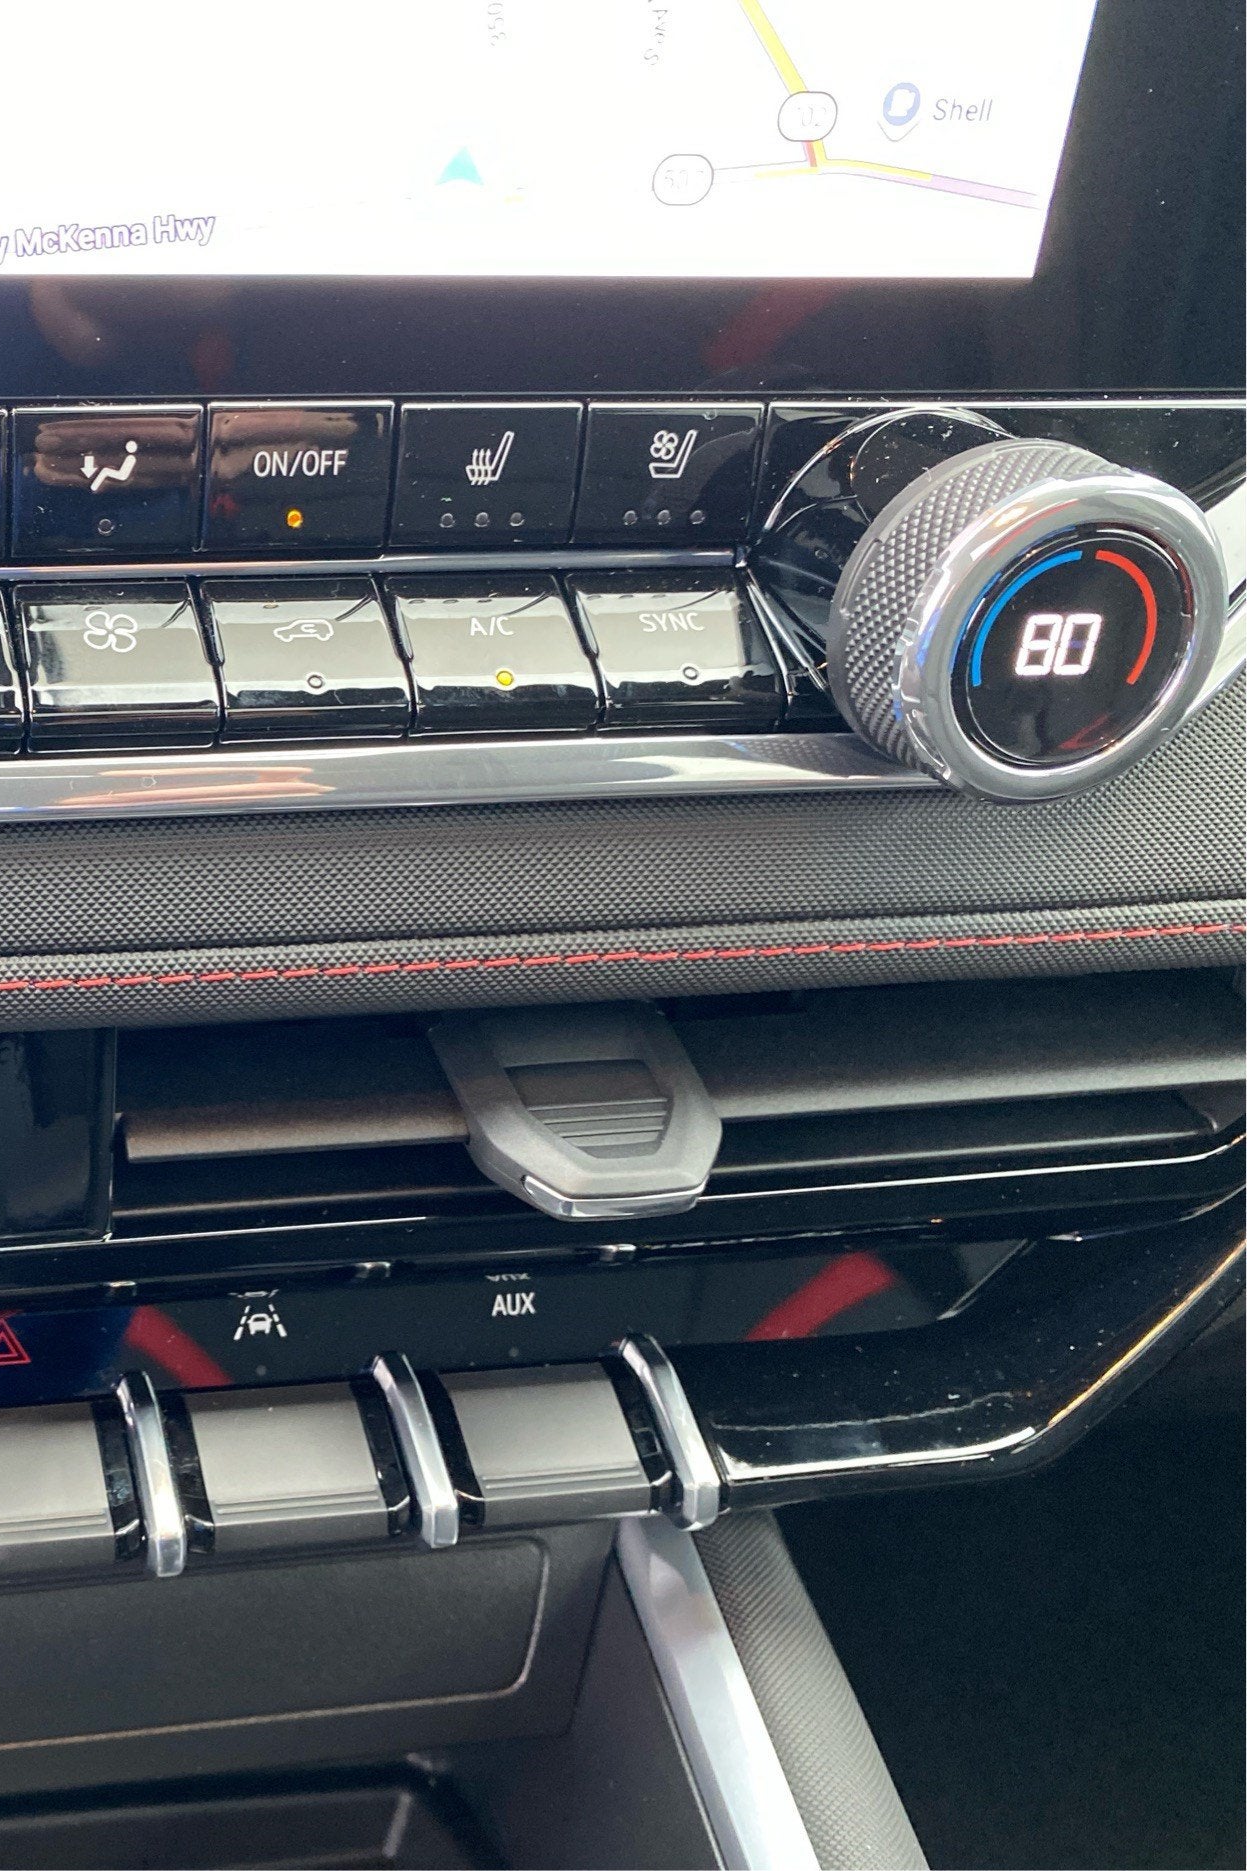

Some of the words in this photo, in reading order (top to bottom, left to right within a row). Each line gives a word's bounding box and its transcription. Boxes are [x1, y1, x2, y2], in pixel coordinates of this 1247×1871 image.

[932, 98, 994, 122] Shell
[15, 223, 148, 257] McKenna
[152, 214, 216, 246] Hwy
[253, 448, 347, 478] ON/OFF
[469, 614, 515, 638] A/C
[638, 611, 706, 634] SYNC
[1014, 612, 1103, 677] 80
[491, 1291, 536, 1317] AUX
